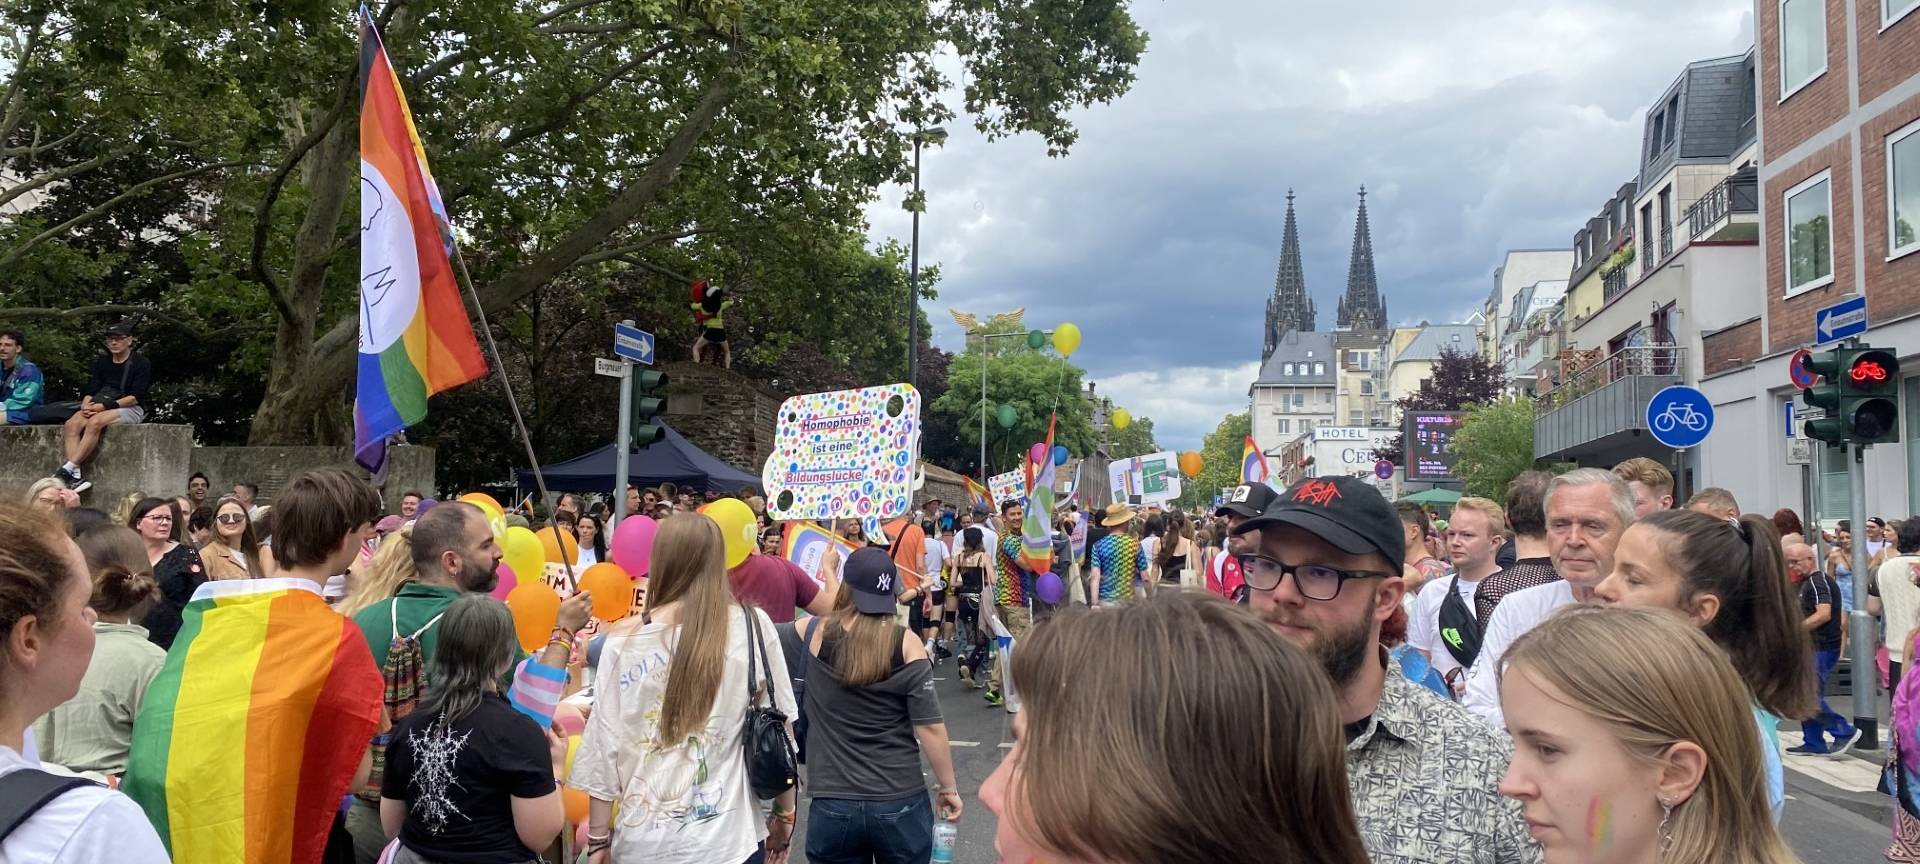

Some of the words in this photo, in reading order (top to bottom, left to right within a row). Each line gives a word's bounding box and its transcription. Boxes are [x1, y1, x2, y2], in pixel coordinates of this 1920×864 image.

[802, 415, 870, 431] Homophobie
[1322, 429, 1364, 438] HOTEL
[812, 442, 826, 453] ist
[829, 440, 853, 452] eine
[785, 471, 862, 485] Bildungslücke
[876, 572, 892, 591] NY
